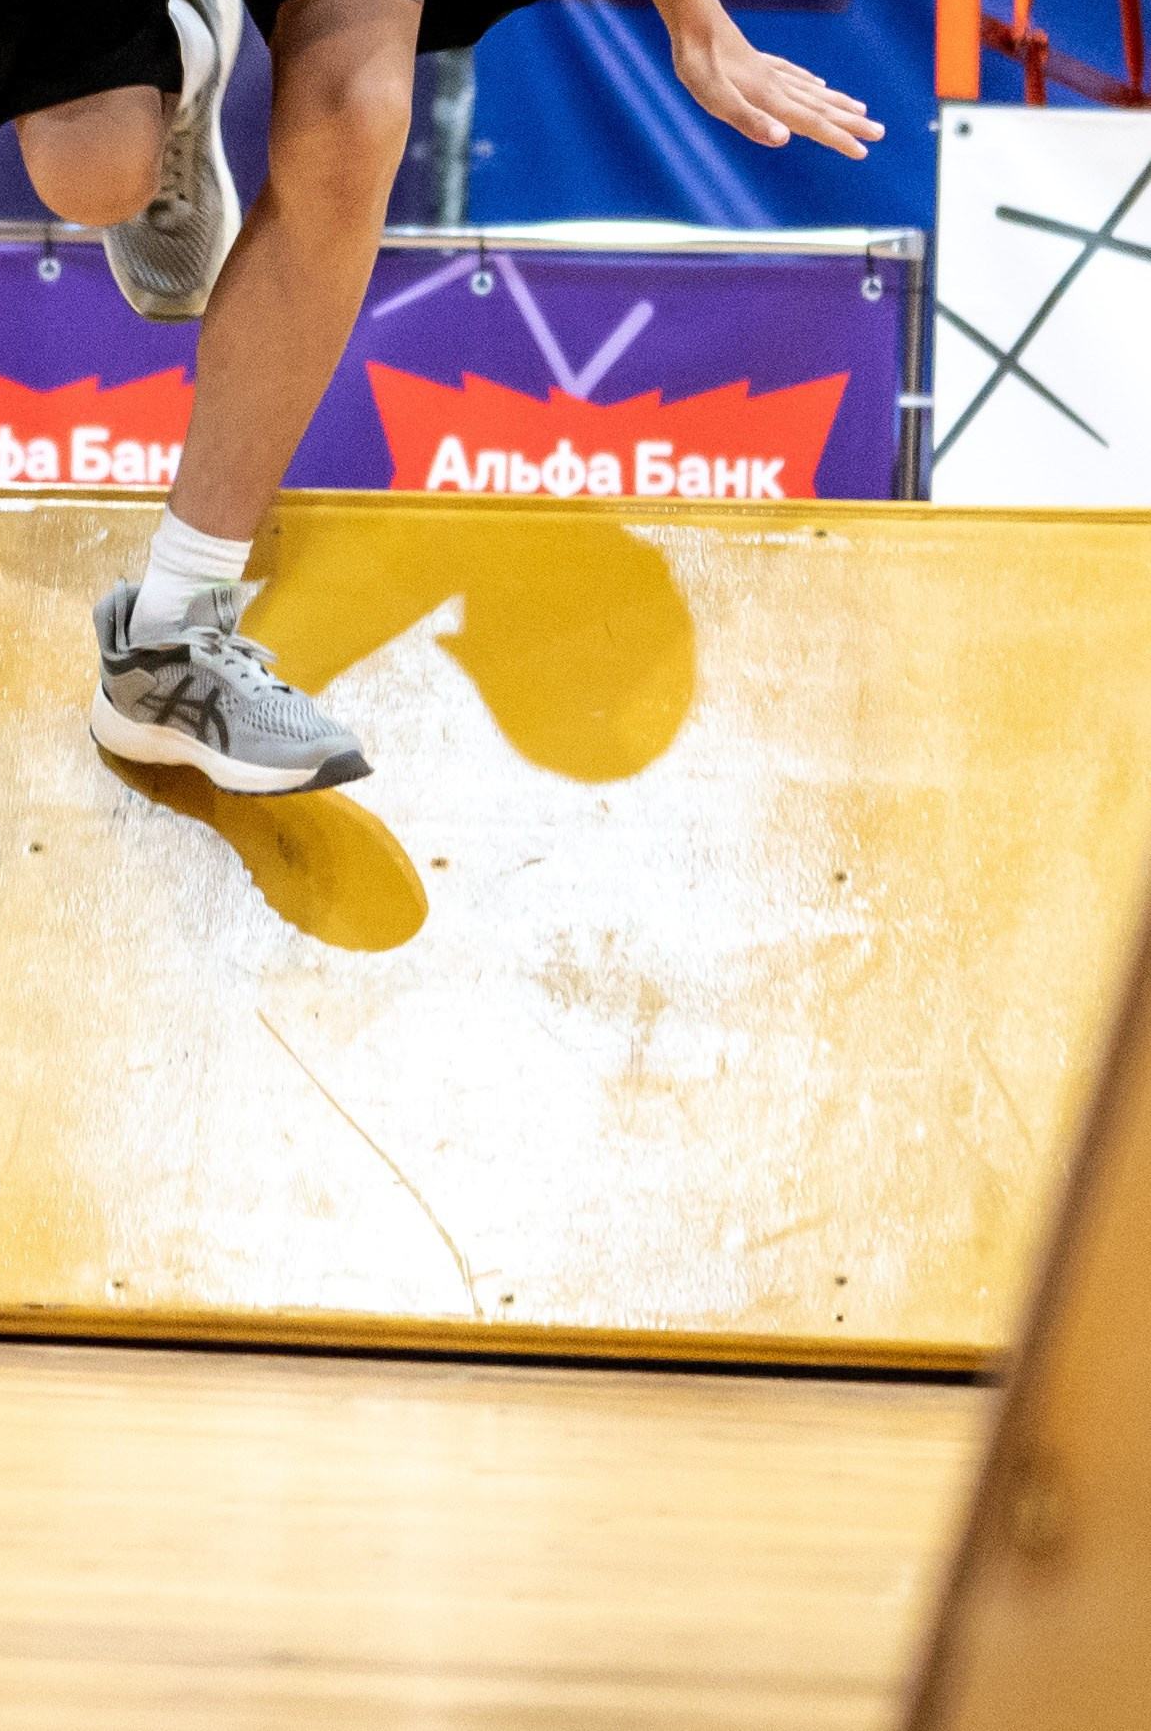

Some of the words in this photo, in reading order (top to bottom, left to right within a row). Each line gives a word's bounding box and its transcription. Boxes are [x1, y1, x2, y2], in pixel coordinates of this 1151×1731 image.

[71, 425, 185, 483] Бан
[425, 435, 623, 498] Альфа
[634, 440, 785, 499] Банк
